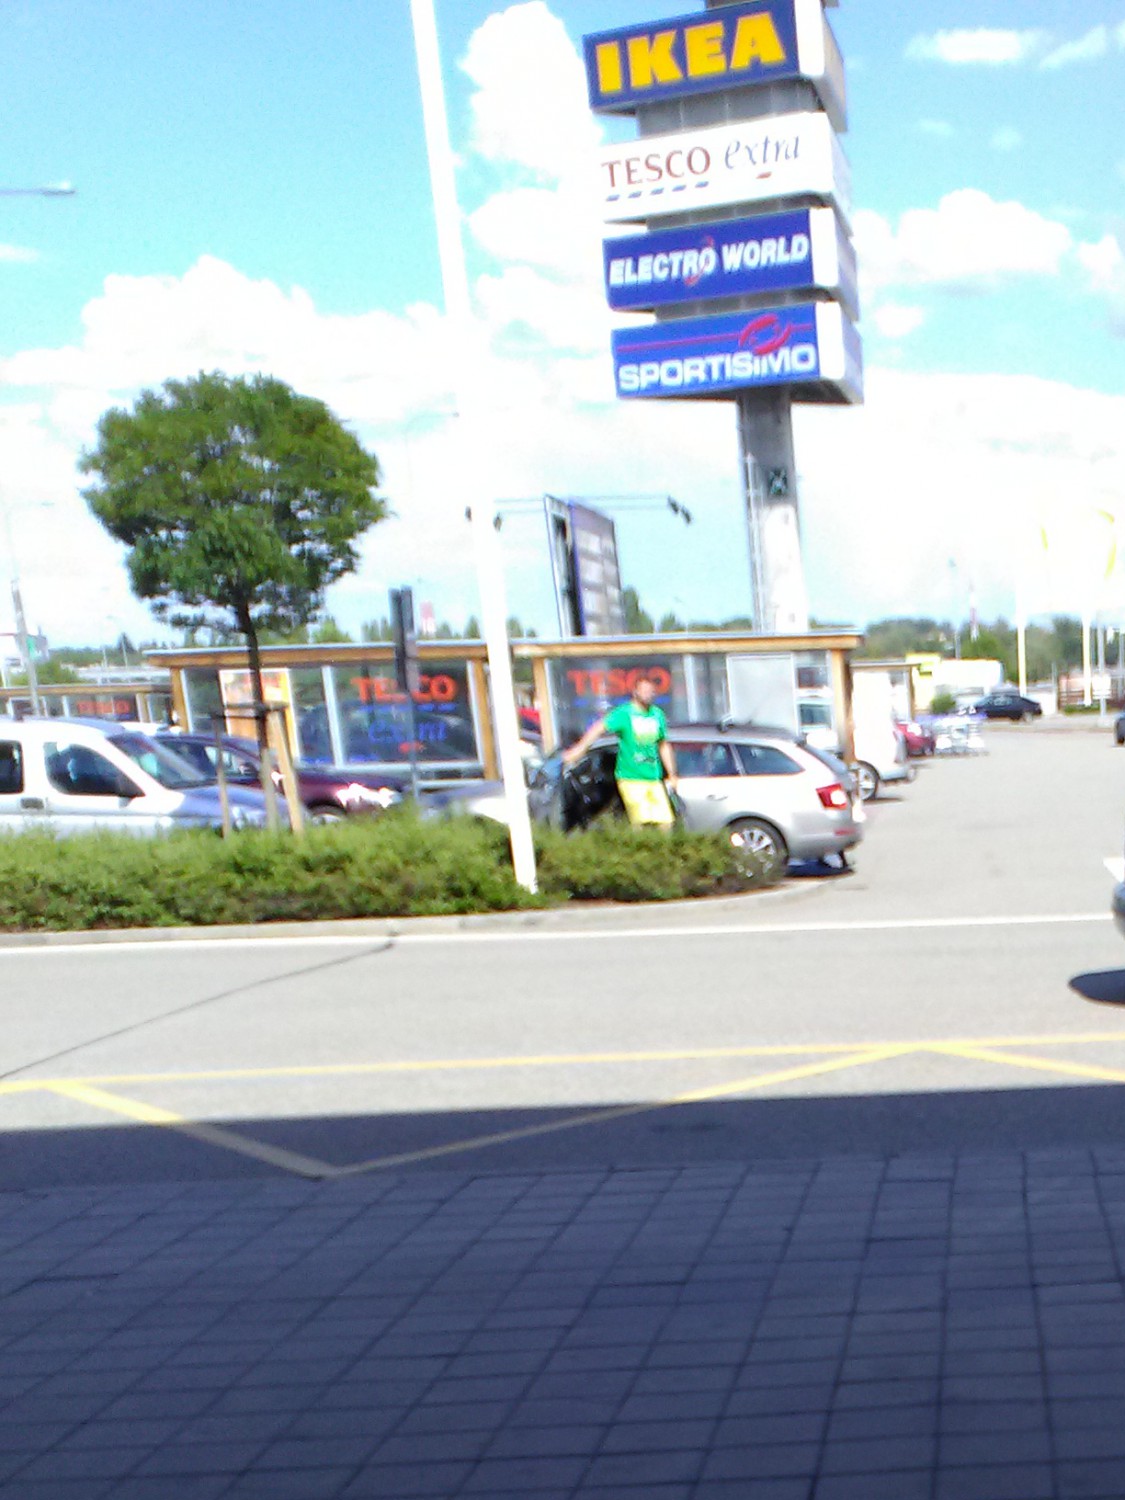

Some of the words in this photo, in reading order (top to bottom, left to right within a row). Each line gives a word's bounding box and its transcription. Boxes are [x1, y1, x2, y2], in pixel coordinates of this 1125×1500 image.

[596, 12, 786, 94] IKEA
[601, 147, 711, 188] TESCO
[724, 136, 800, 170] extra
[608, 247, 717, 286] ELECTRO
[722, 233, 810, 274] WORLD
